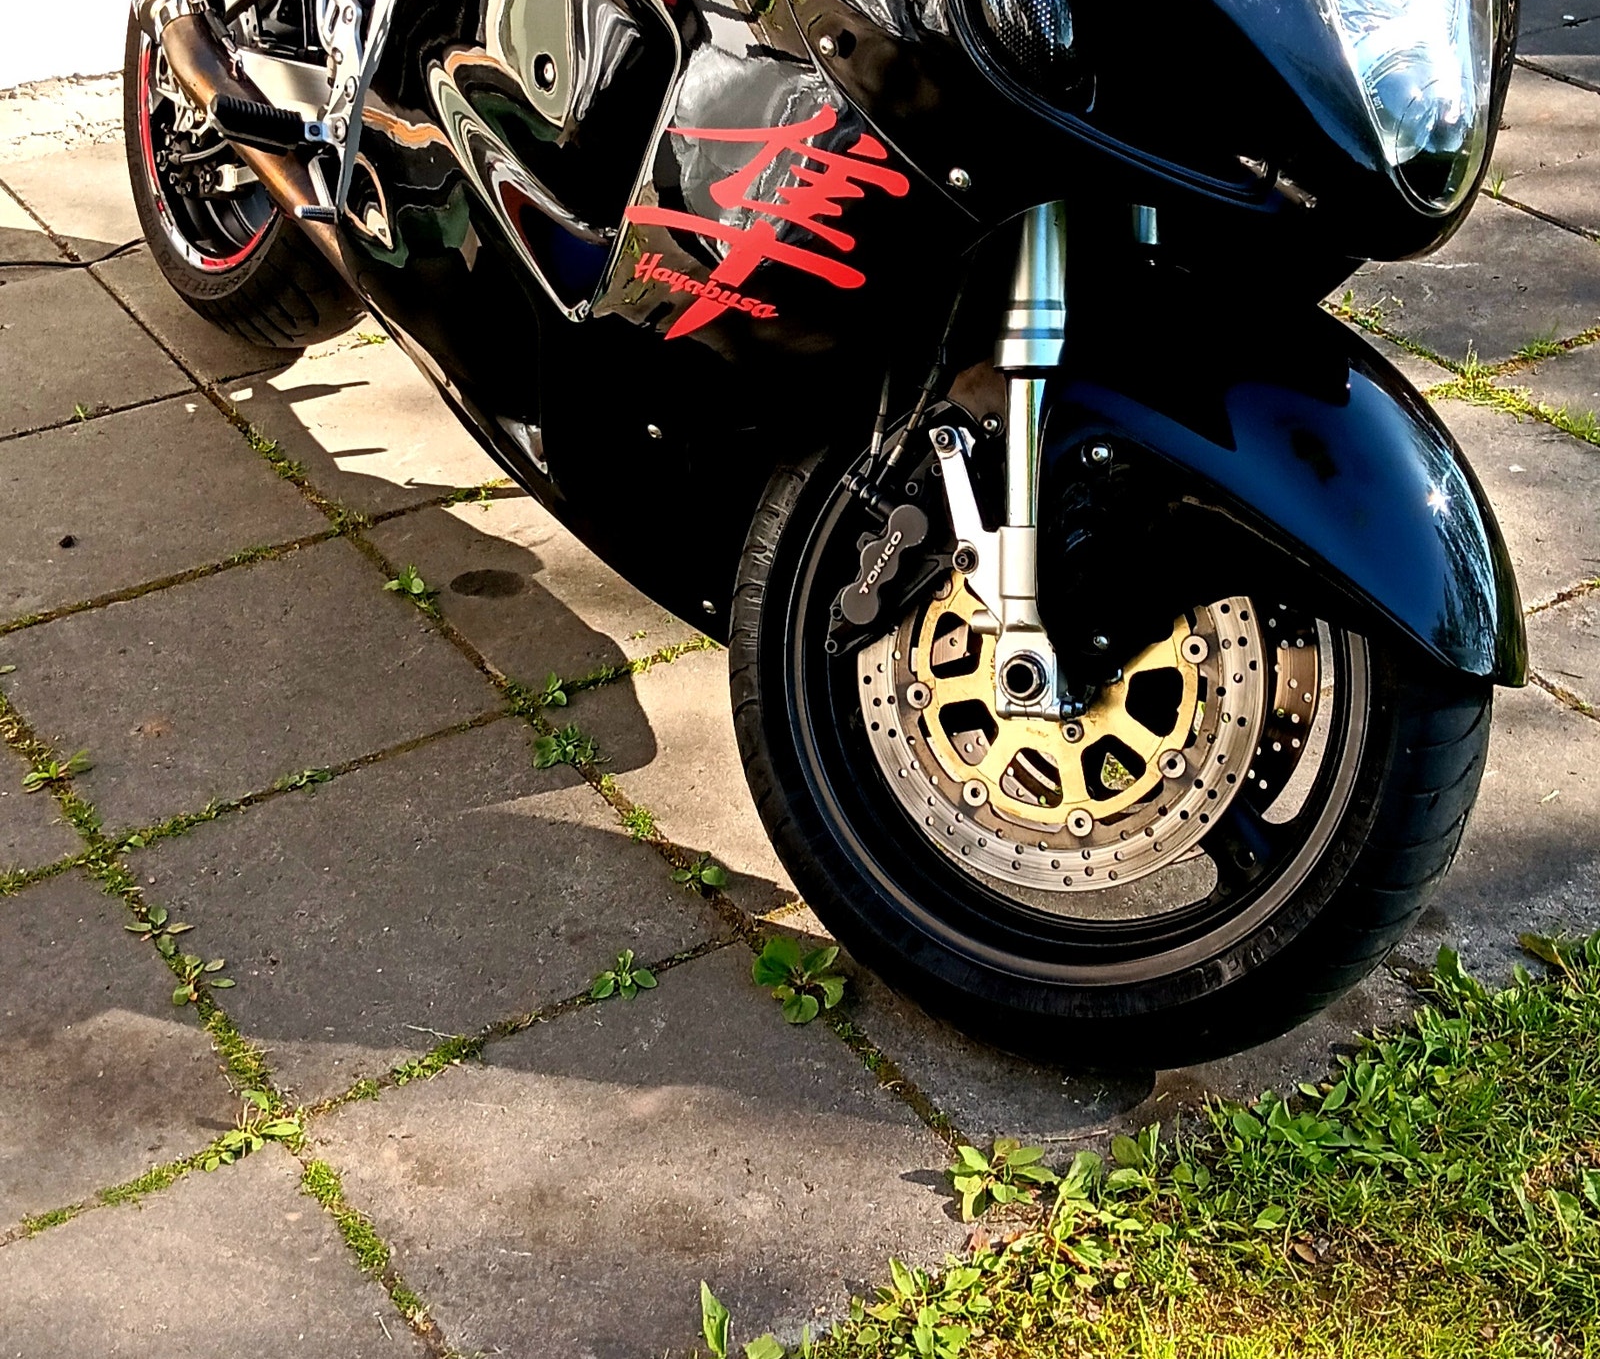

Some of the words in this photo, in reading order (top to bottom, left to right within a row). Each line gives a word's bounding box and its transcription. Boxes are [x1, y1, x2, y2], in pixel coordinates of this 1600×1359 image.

[625, 103, 910, 340] 隼
[634, 252, 779, 319] Hayabusa
[858, 531, 902, 594] TOKICO
